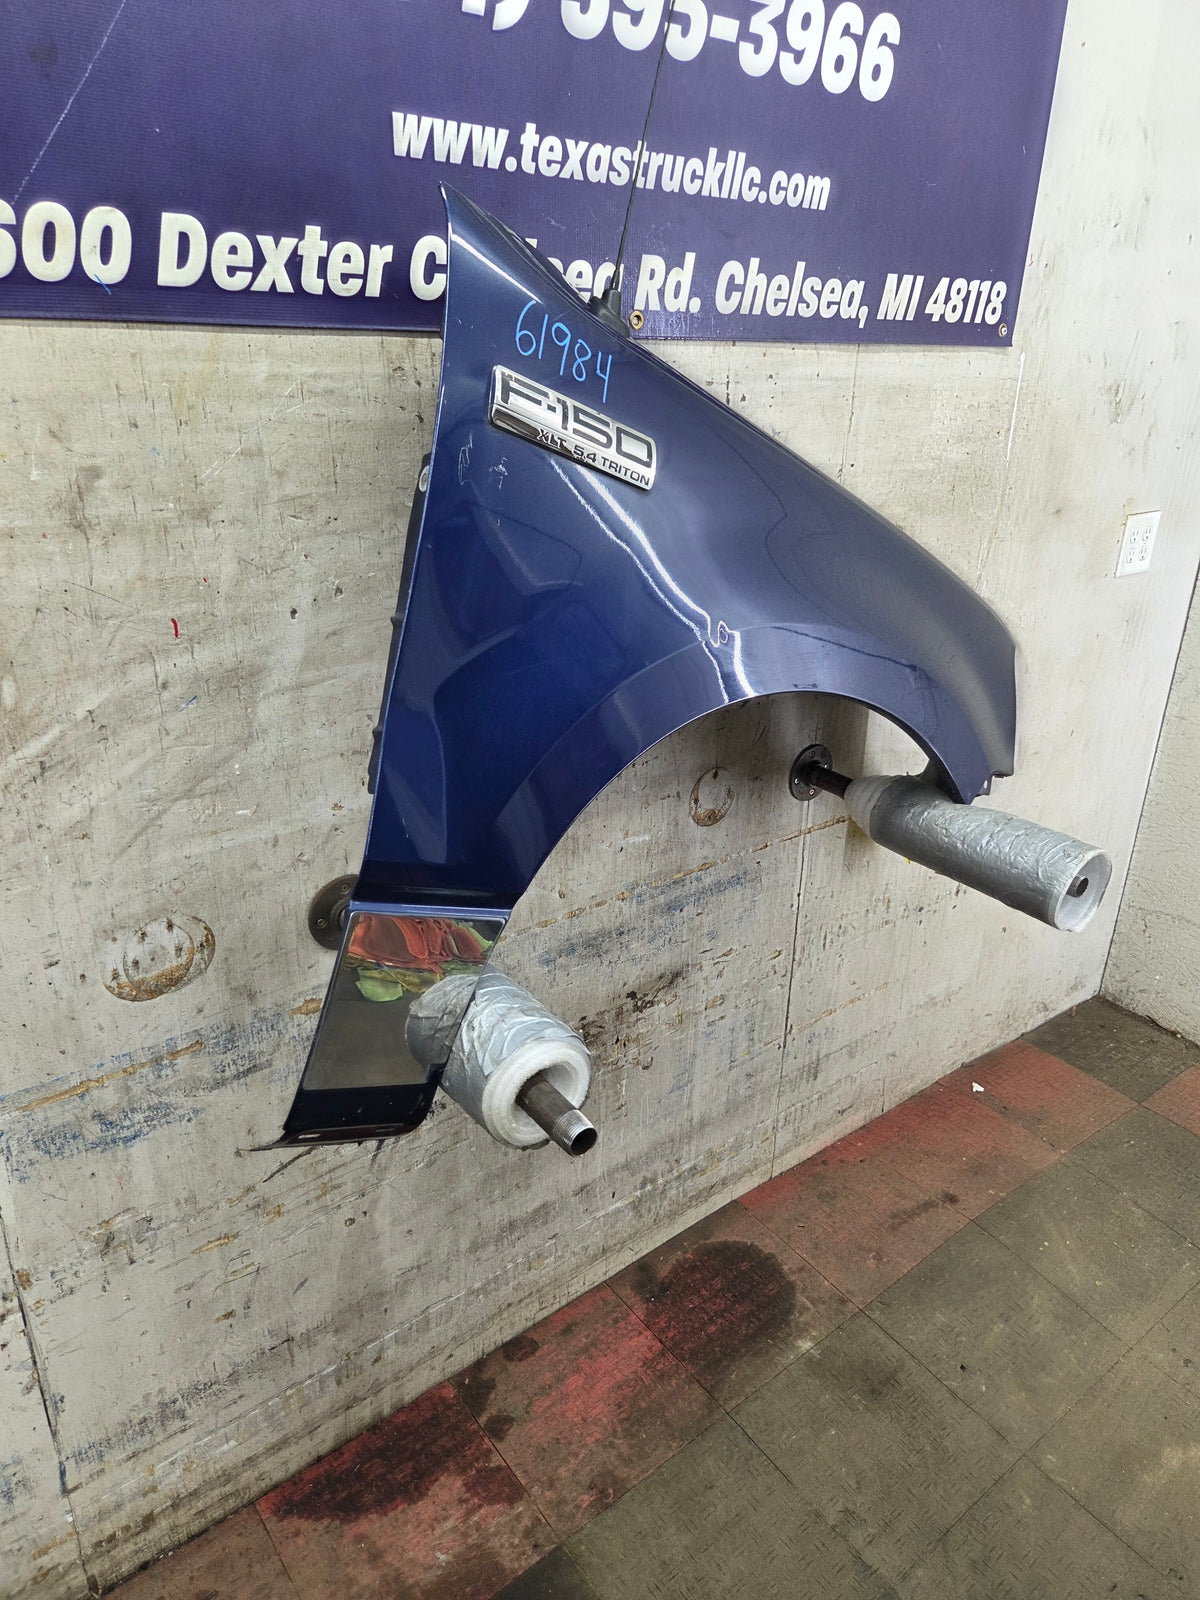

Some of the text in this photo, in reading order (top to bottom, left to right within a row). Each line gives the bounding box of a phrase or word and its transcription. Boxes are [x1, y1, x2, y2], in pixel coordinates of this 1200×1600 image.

[392, 111, 831, 210] www.texastruckllc.com
[158, 212, 394, 298] Dexter
[634, 252, 702, 313] Rd.
[715, 256, 868, 328] Chelsea,
[877, 273, 925, 321] MI
[925, 277, 1007, 325] 48118
[515, 299, 612, 403] 61984
[501, 371, 653, 469] F-150
[537, 428, 567, 450] XLT
[601, 456, 650, 486] TRITON
